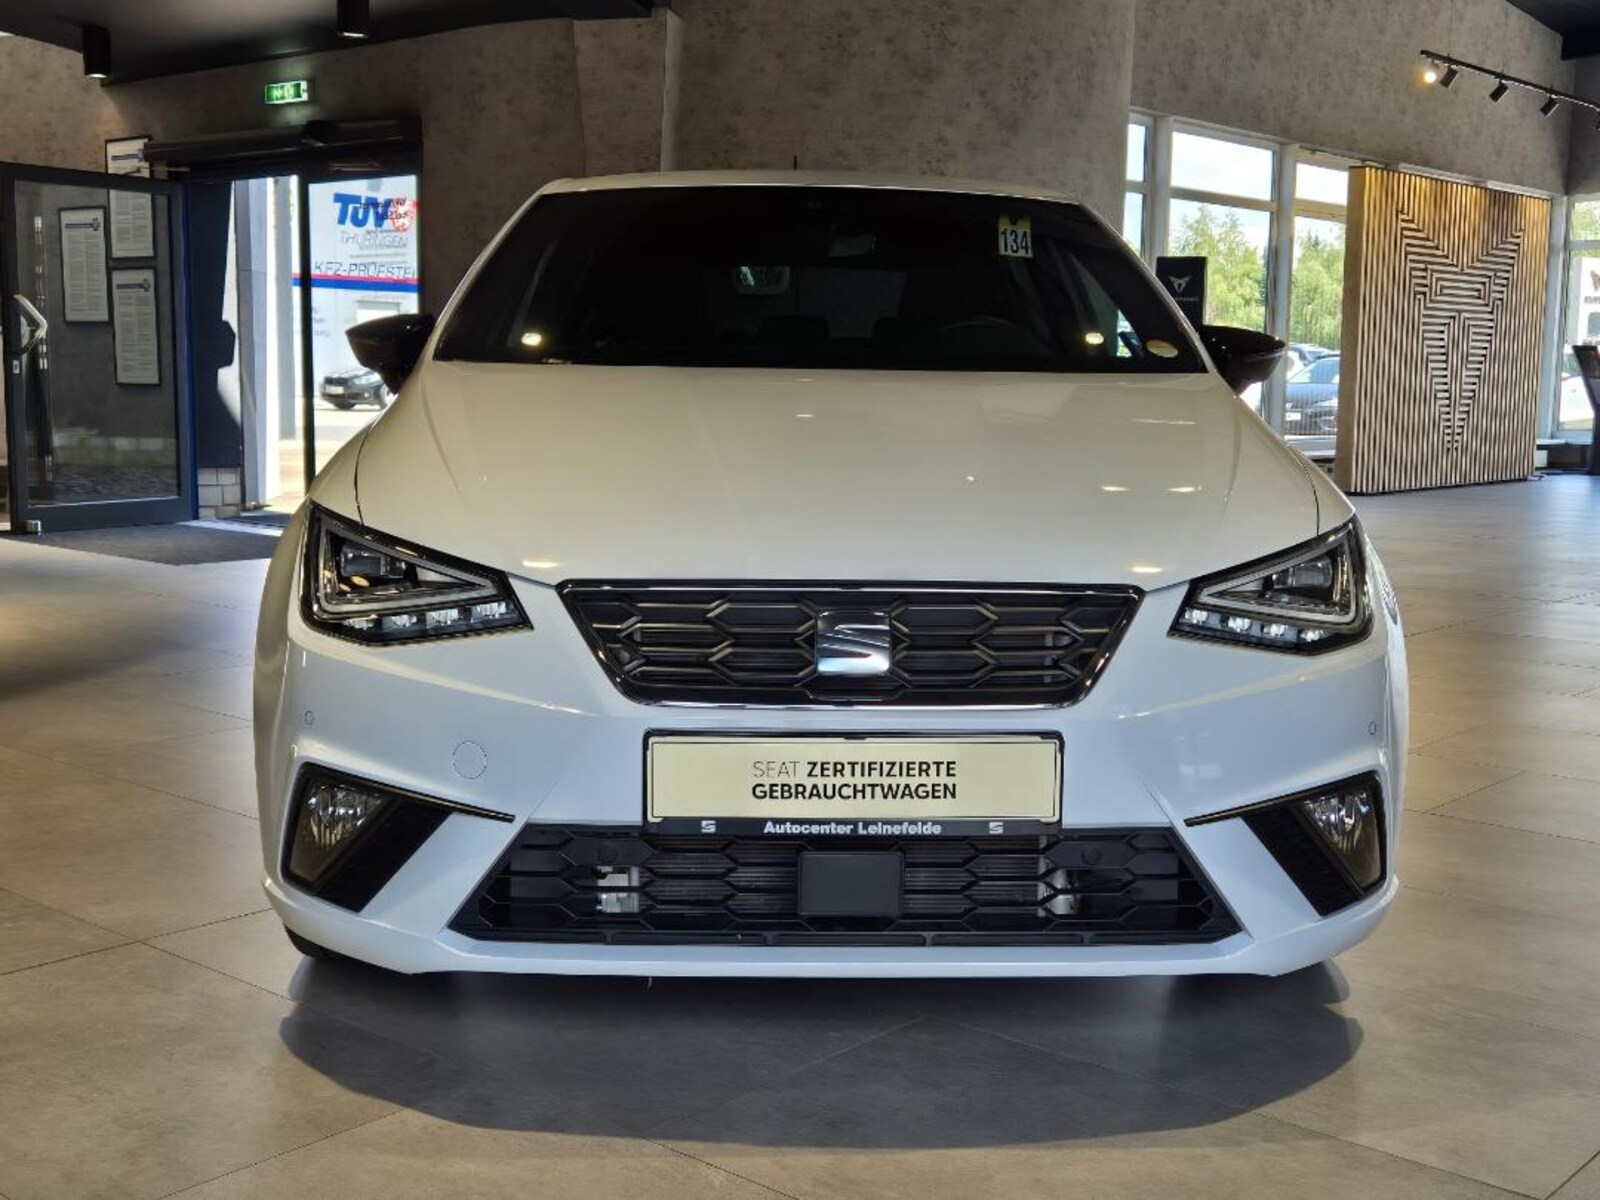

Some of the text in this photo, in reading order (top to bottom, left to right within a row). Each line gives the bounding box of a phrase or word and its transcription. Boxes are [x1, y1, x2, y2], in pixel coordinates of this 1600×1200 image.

[1001, 227, 1029, 255] 134
[753, 761, 956, 778] SEAT ZERTIFIZIERTE
[752, 783, 957, 800] GEBRAUCHTWAGEN
[763, 821, 942, 835] Autocenter Leinefelde
